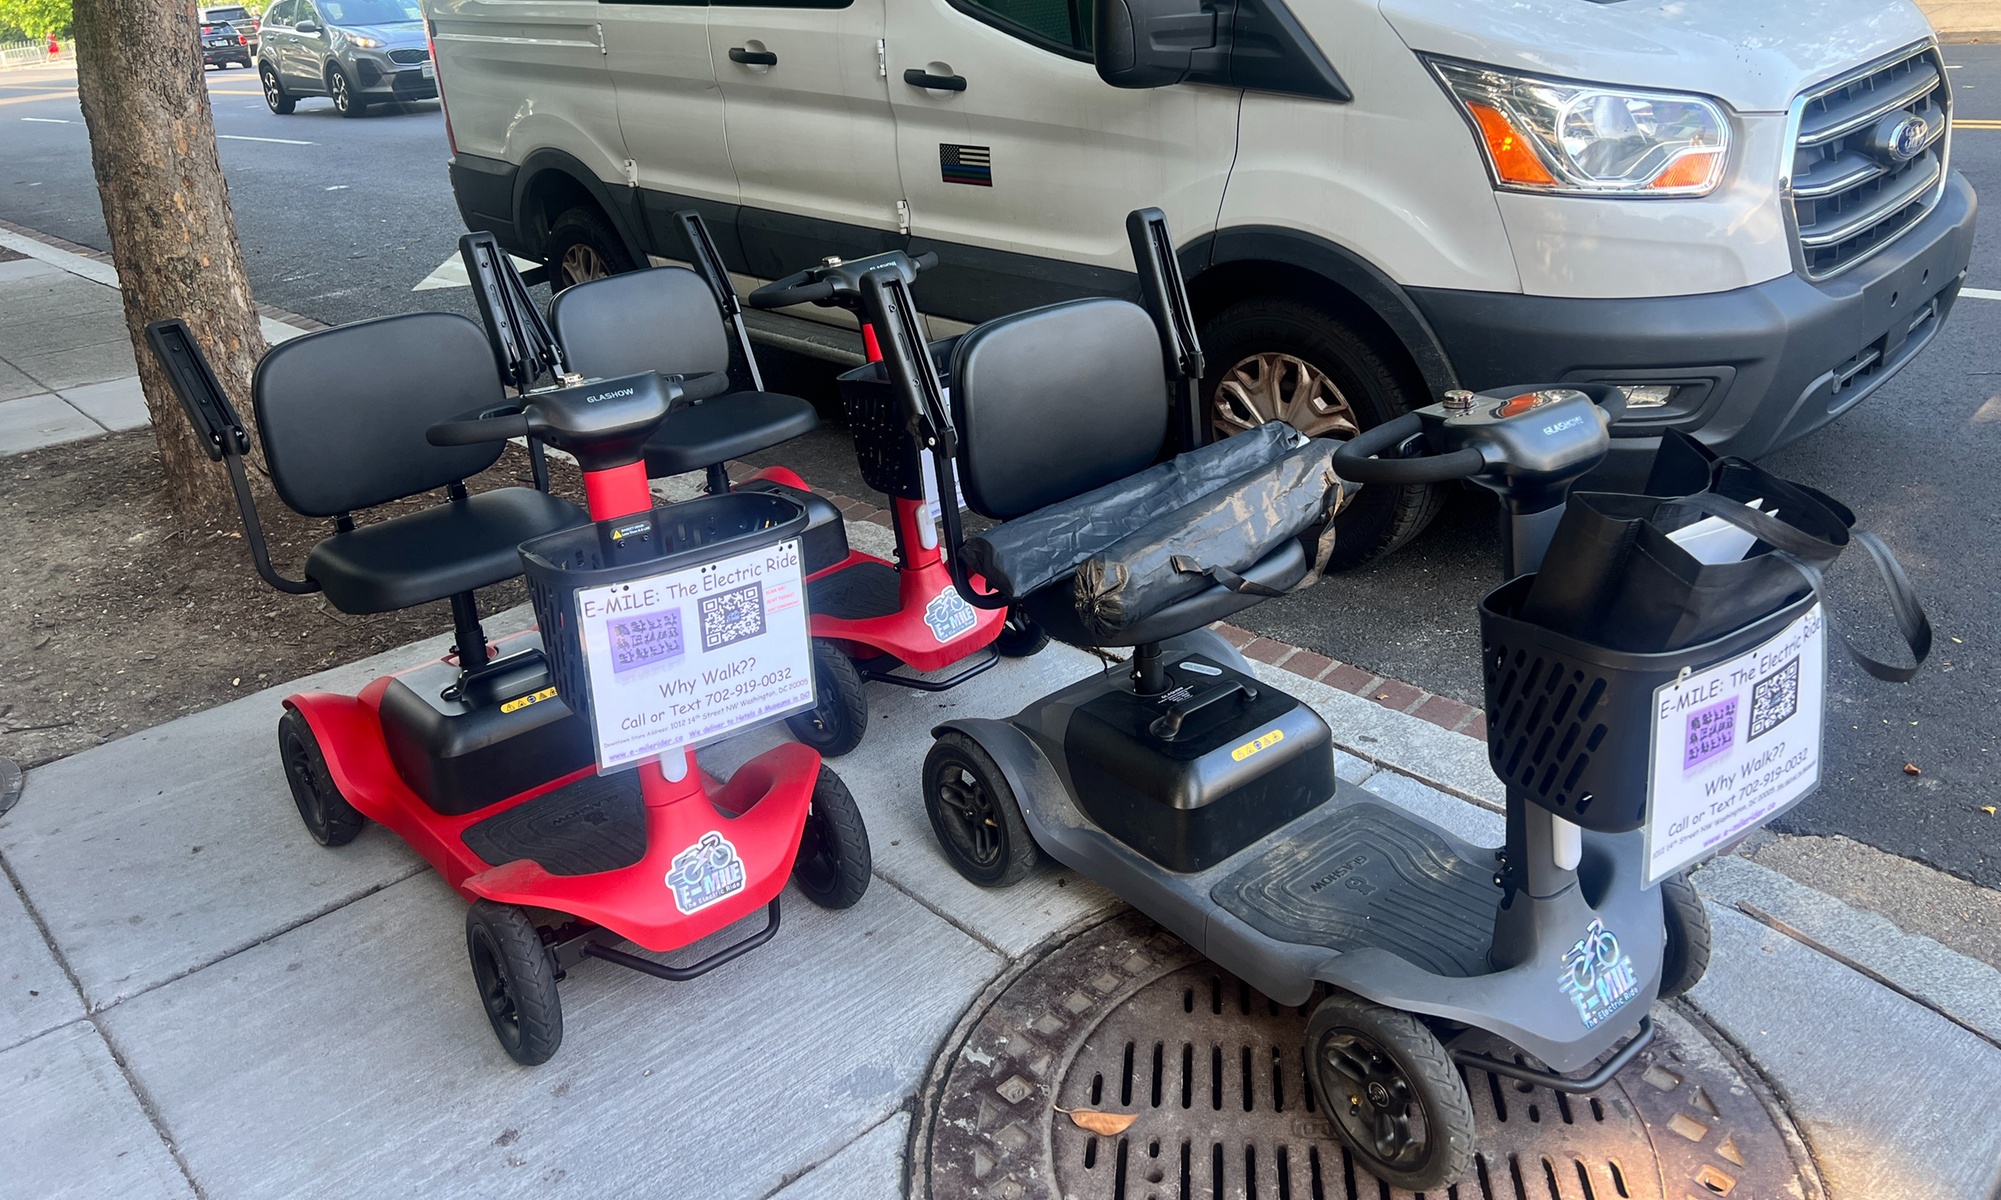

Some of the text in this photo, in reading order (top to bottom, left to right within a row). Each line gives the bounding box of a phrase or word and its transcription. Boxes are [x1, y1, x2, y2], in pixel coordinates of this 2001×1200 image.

[586, 388, 634, 403] GLASHOW
[1543, 416, 1584, 435] GLASHOW
[584, 553, 797, 618] E-MILE: The Electric Ride
[659, 657, 756, 698] Why Walk??
[1660, 617, 1822, 719] E-MILE: The Electric Ride
[621, 667, 792, 730] Call or Text 702-919-0032
[671, 720, 686, 729] 1012
[703, 708, 724, 720] Street
[726, 702, 739, 712] NW
[740, 690, 777, 707] Washington,
[778, 686, 788, 694] DC
[789, 678, 808, 690] 20005
[689, 729, 701, 739] We
[703, 722, 724, 734] deliver
[727, 718, 734, 726] to
[736, 710, 756, 723] Hotels
[765, 698, 791, 712] Museums
[1705, 773, 1736, 797] Why
[1741, 742, 1785, 778] Walk??
[553, 794, 619, 825] GLASHOW
[1669, 816, 1689, 836] Call
[1692, 812, 1705, 825] or
[1709, 795, 1736, 815] Text
[1739, 748, 1808, 801] 702-919-0032
[1679, 830, 1699, 844] Street
[1700, 822, 1713, 833] NW
[679, 862, 742, 905] E-MILE
[1310, 855, 1368, 893] GLASHOW
[684, 882, 740, 910] The Electric Ride
[1573, 956, 1638, 1022] E-MILE
[1585, 987, 1639, 1029] The Electric Ride
